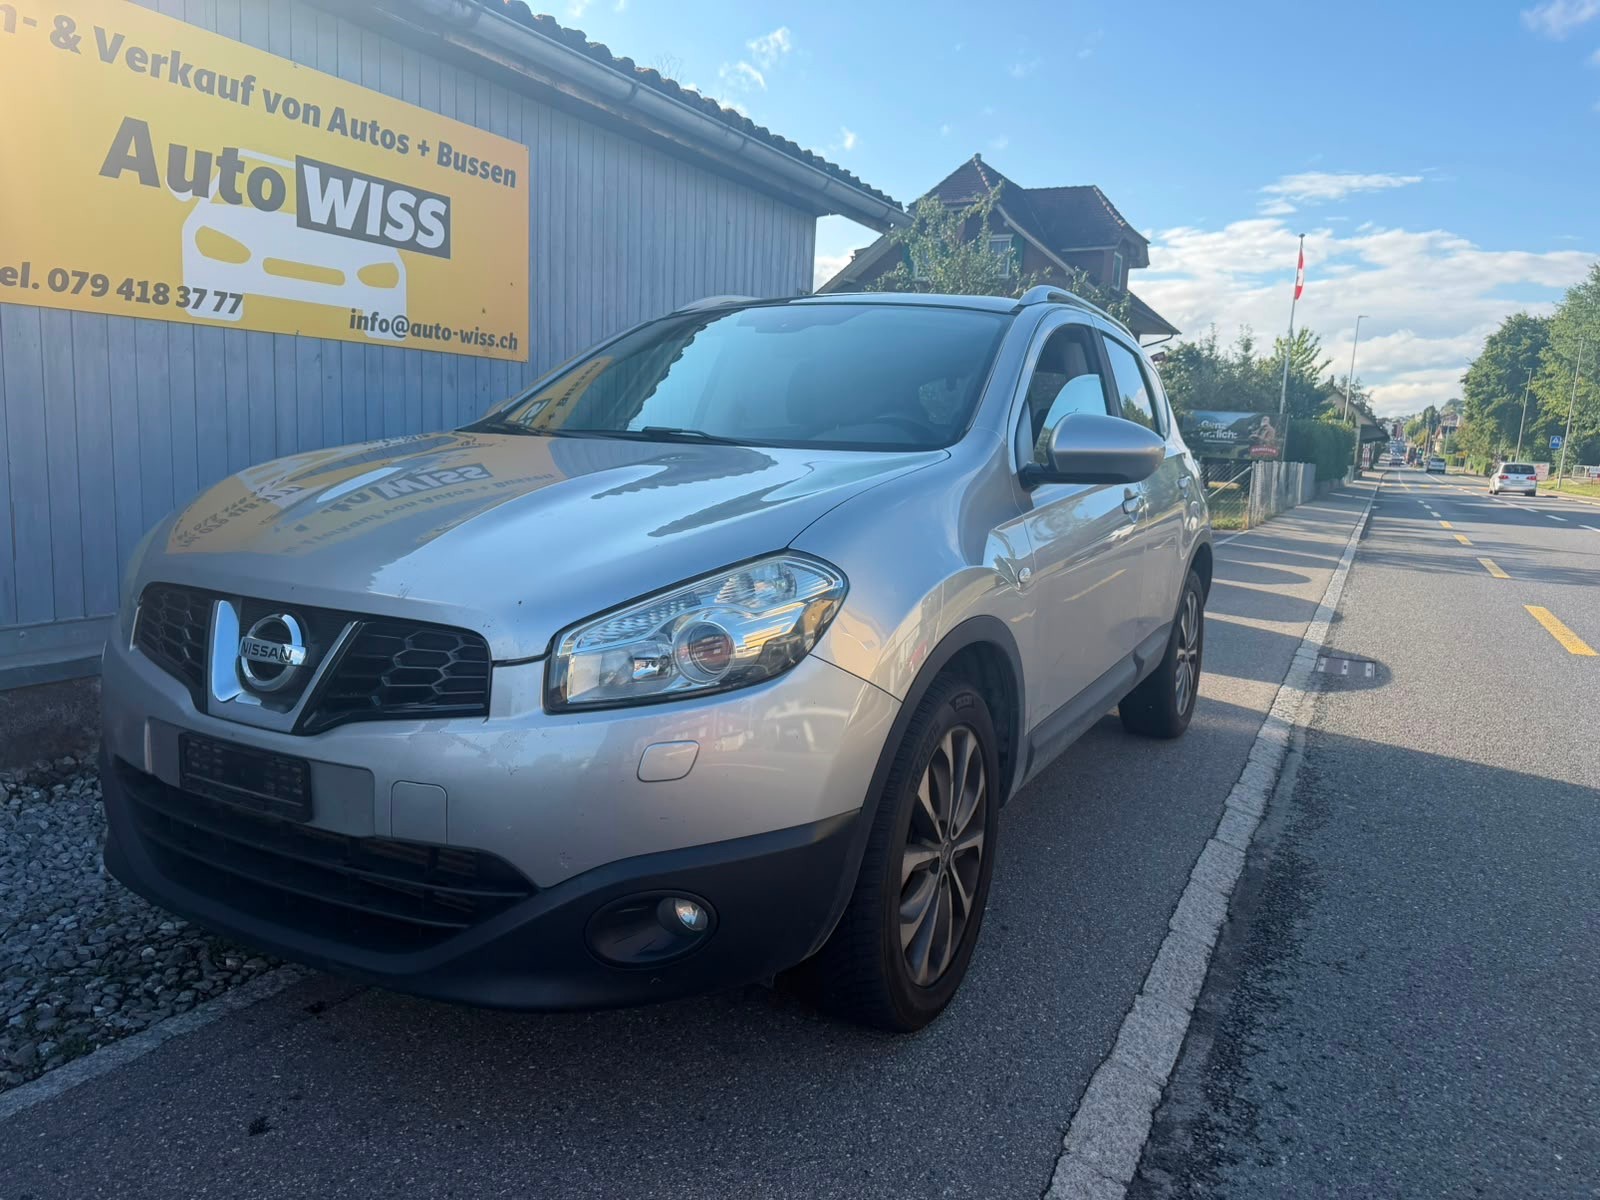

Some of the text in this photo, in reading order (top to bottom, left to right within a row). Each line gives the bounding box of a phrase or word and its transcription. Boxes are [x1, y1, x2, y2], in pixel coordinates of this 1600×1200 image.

[50, 14, 81, 54] &
[93, 25, 256, 106] Verkauf
[263, 88, 321, 128] von
[327, 106, 410, 155] Autos
[417, 140, 430, 157] +
[437, 141, 516, 188] Bussen
[99, 116, 448, 249] Auto WISS
[48, 268, 110, 297] 079
[116, 278, 170, 305] 418
[176, 286, 208, 310] 37
[213, 291, 243, 314] 77
[349, 308, 518, 350] info@auto-wiss.ch
[241, 641, 293, 662] NISSAN
